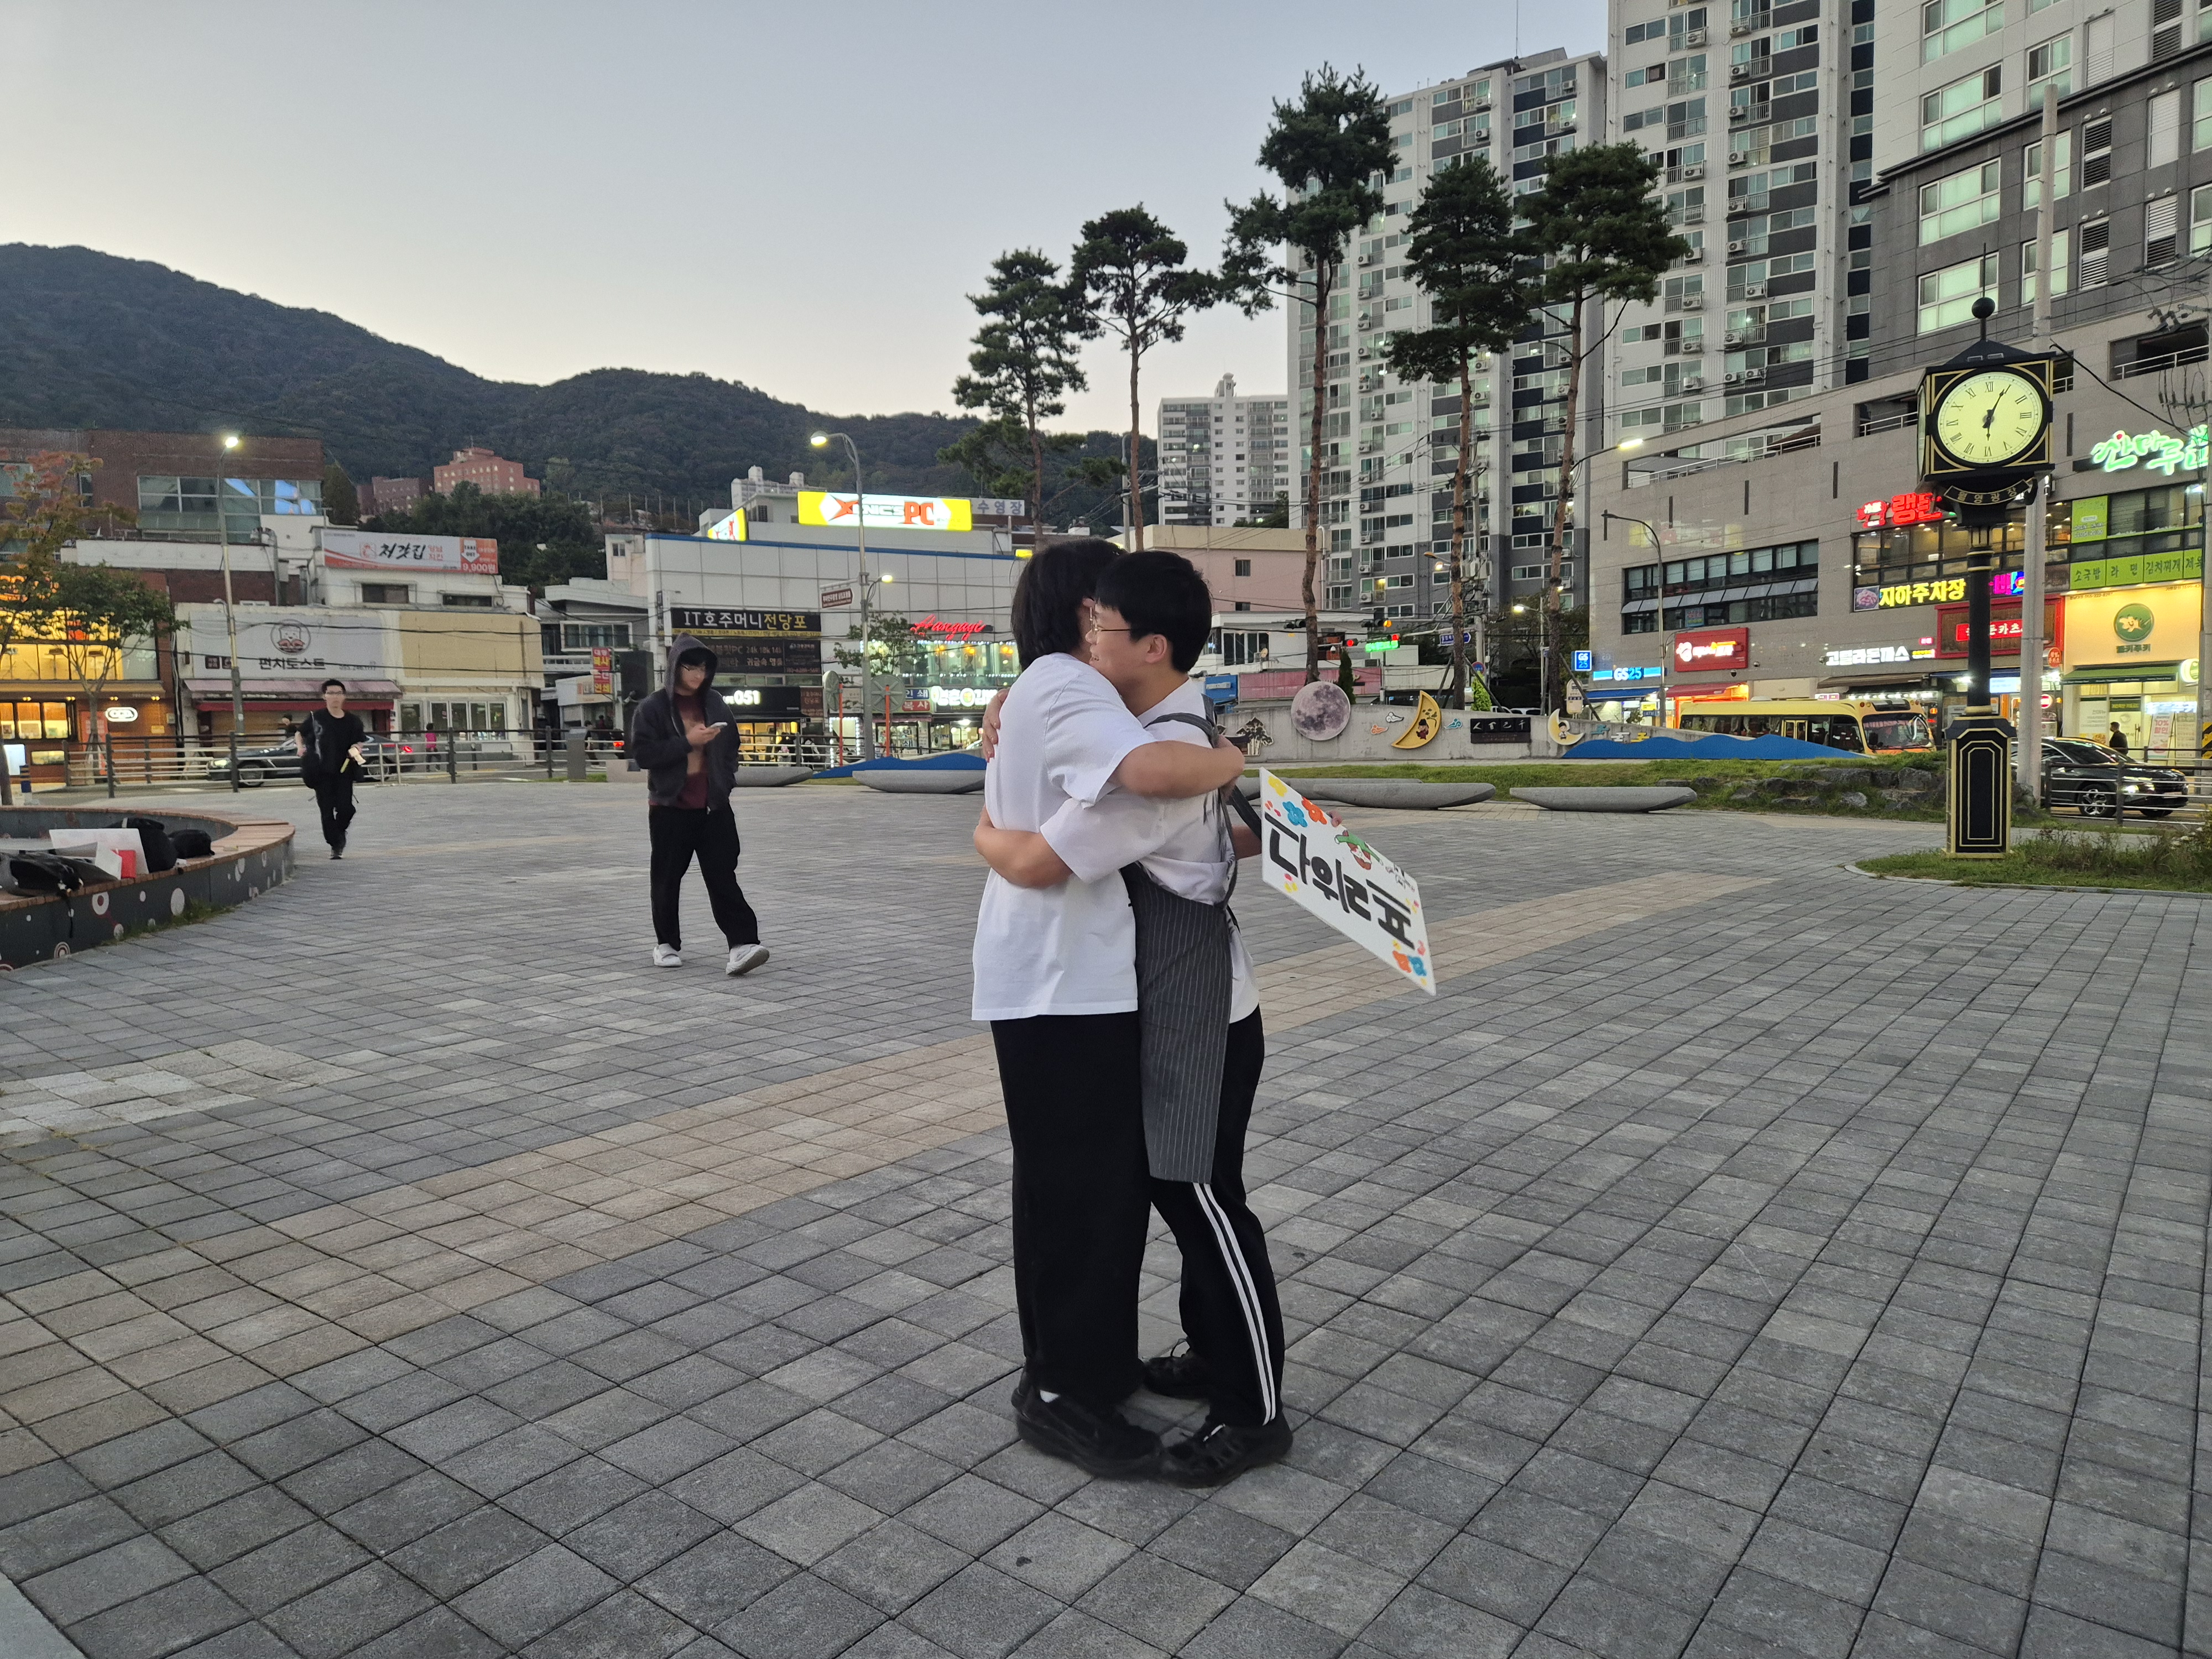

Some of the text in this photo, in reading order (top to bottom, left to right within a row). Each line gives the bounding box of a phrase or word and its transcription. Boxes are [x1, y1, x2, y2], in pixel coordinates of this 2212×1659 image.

[1957, 487, 2017, 504] 월영광장
[904, 500, 935, 525] PC
[978, 499, 1022, 515] 수영장
[379, 542, 426, 560] 처갓집
[2075, 567, 2101, 582] 소국밥
[1879, 578, 1966, 607] 지하주차장
[1613, 667, 1642, 681] GS25
[734, 690, 761, 705] 051
[904, 701, 928, 710] 복사
